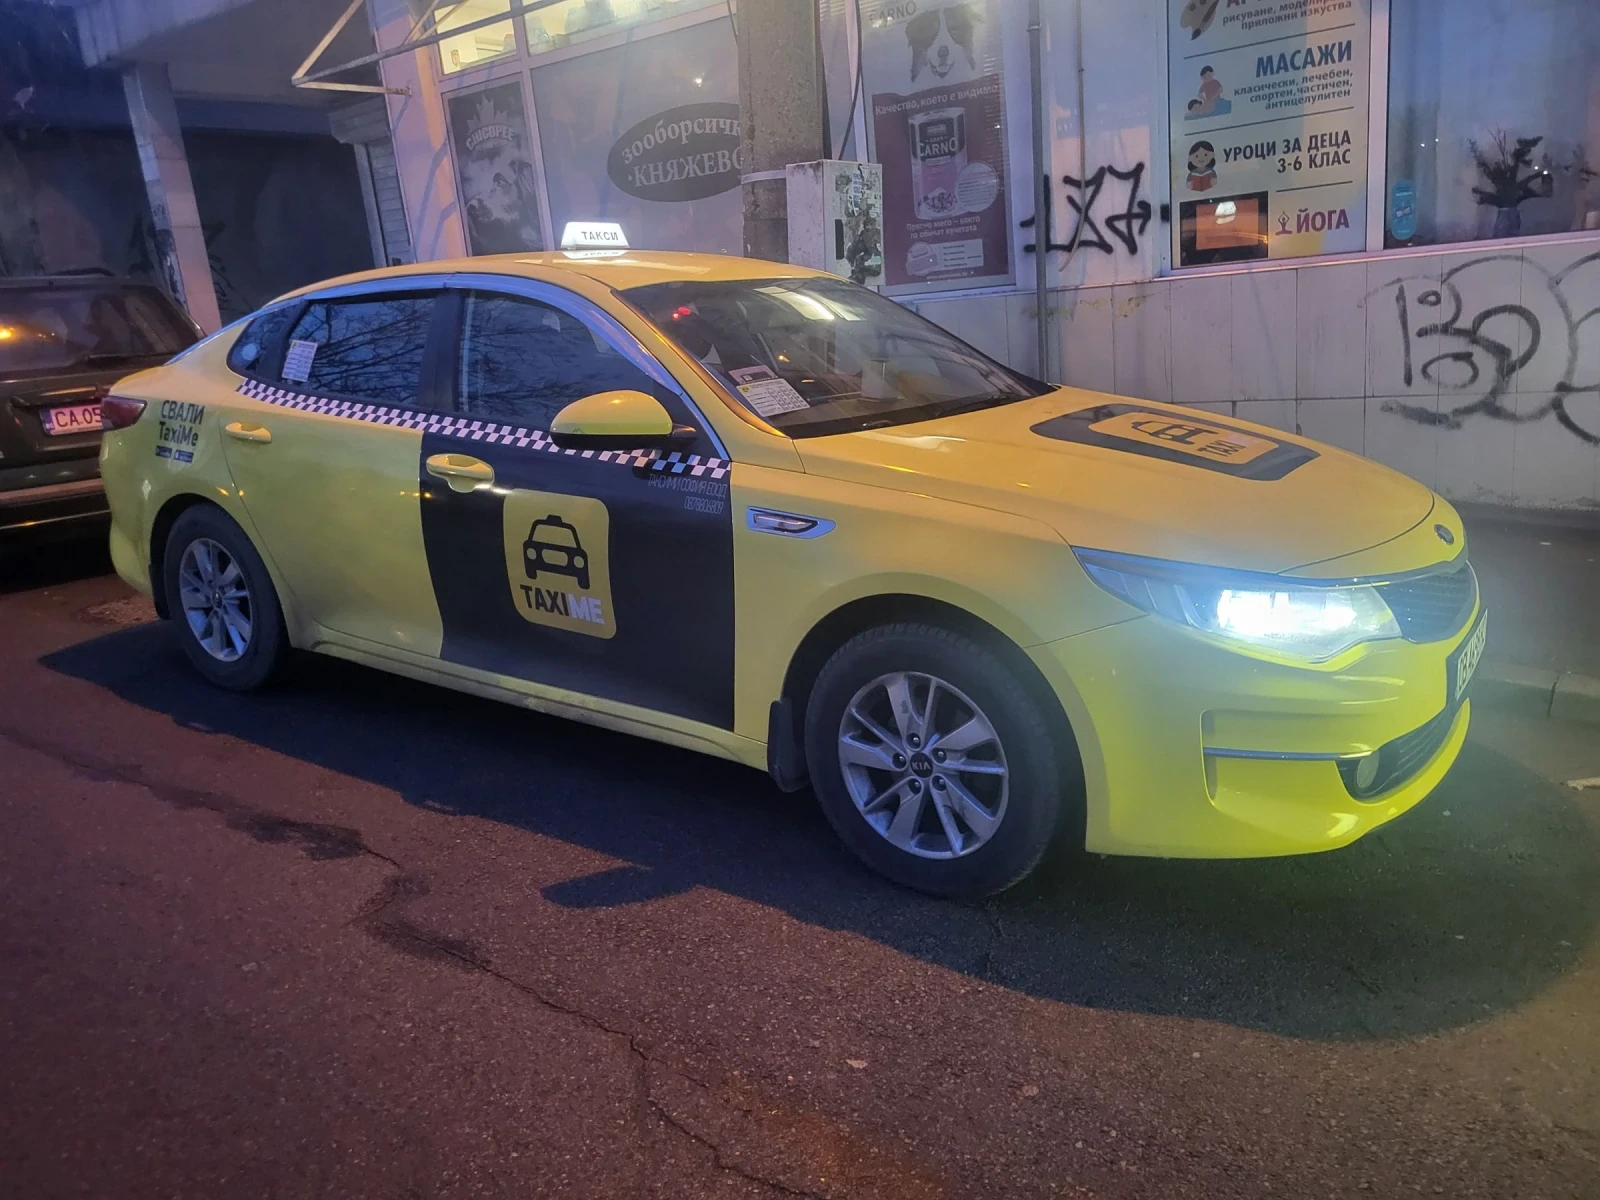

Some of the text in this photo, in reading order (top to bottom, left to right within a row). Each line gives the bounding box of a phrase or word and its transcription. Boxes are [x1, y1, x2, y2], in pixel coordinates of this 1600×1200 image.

[1222, 7, 1276, 26] рисуване,
[1279, 0, 1337, 13] моделир
[1241, 2, 1352, 30] приложни изкуства
[1256, 40, 1352, 78] МАСАЖИ
[1234, 68, 1353, 96] класически, лечебен,
[875, 100, 920, 115] Качество,
[920, 94, 948, 106] което
[949, 92, 956, 101] е
[1265, 89, 1351, 110] антицелулитен
[465, 124, 514, 151] CHICOPEE
[621, 117, 740, 164] зооборсичк
[918, 137, 957, 156] CARNO
[1223, 130, 1351, 163] УРОЦИ ЗА ДЕЦА
[1277, 149, 1351, 174] 3-6 КЛАС
[1296, 208, 1350, 234] ЙОГА
[581, 231, 619, 240] ТАКСИ
[161, 400, 205, 425] СВАЛИ
[159, 421, 199, 447] TaxiMe
[911, 761, 931, 770] KIA
